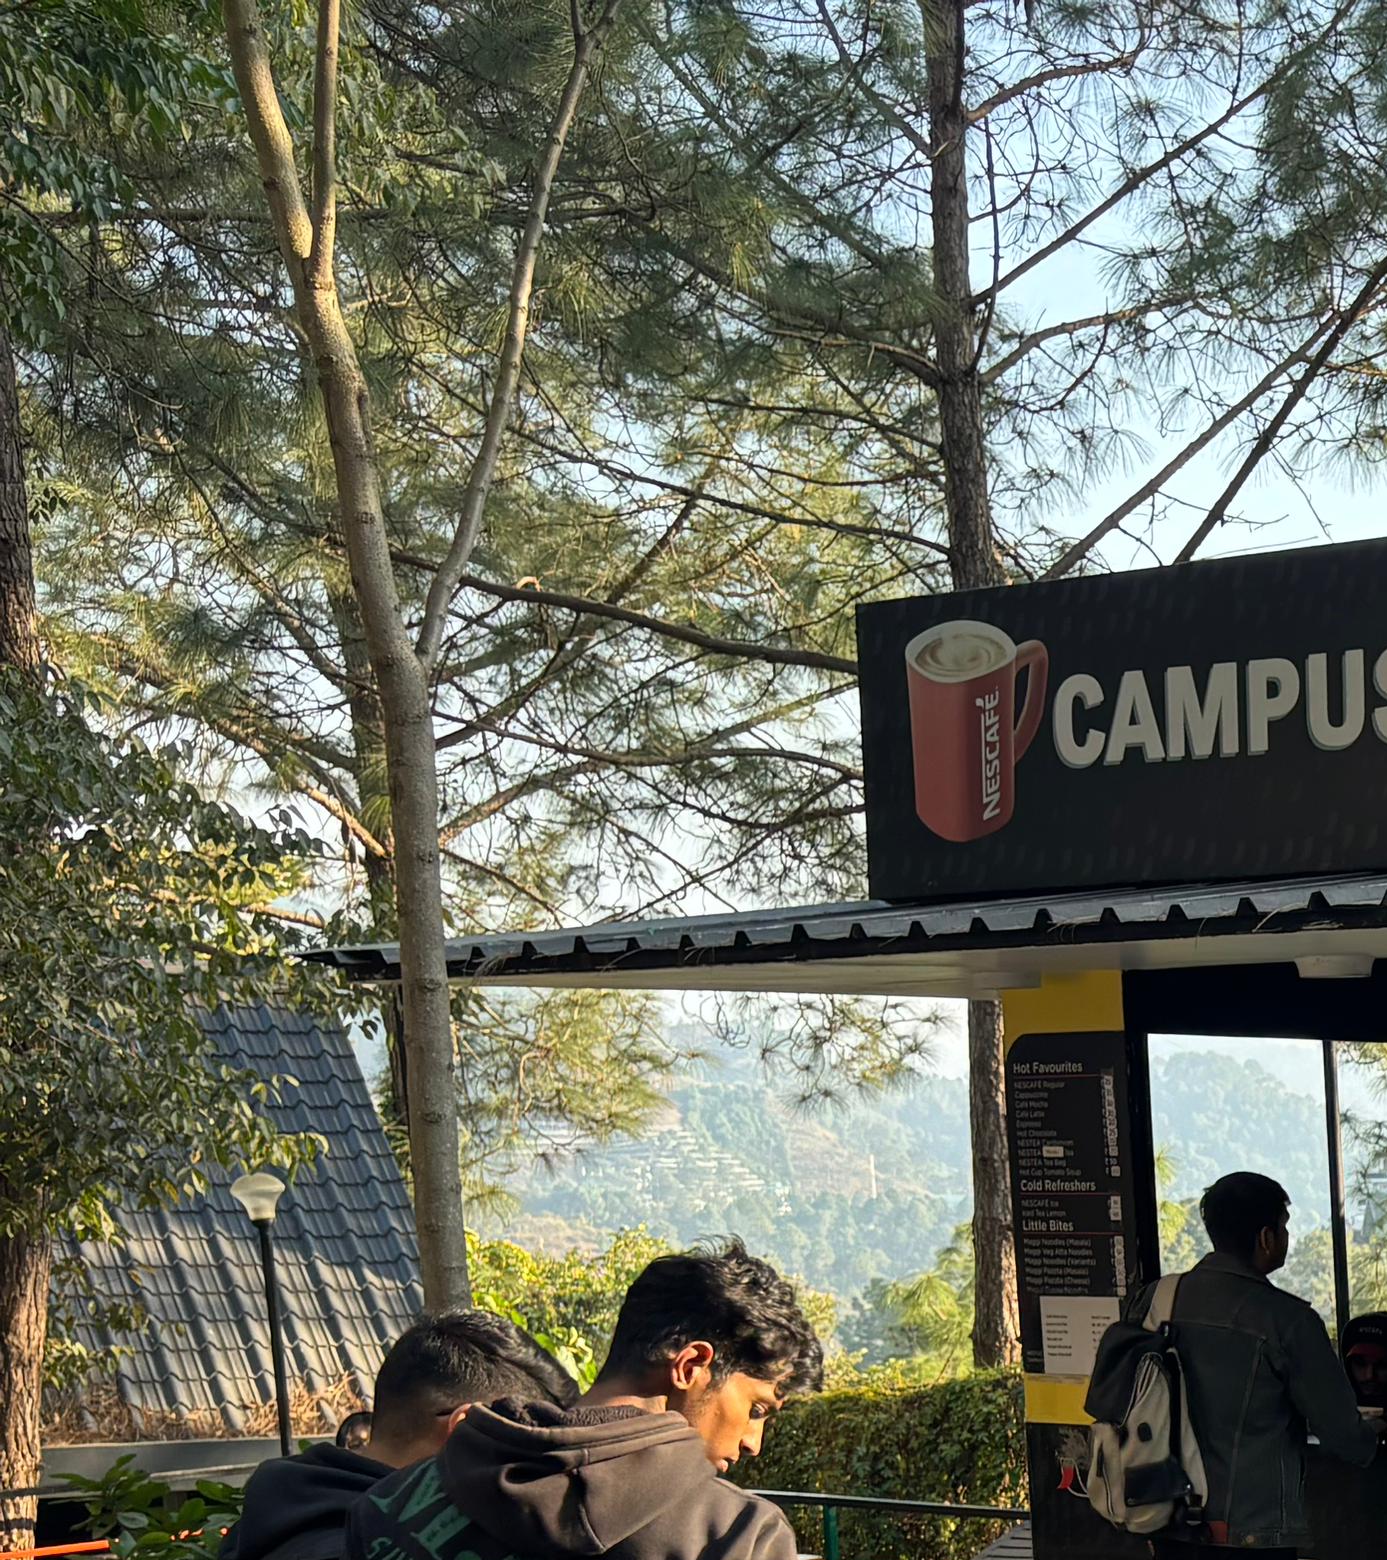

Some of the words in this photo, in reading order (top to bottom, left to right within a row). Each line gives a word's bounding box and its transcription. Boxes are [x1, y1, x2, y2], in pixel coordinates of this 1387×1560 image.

[1013, 1063, 1030, 1074] Hot
[1033, 1061, 1083, 1073] Favourites
[1021, 1180, 1042, 1191] Cold
[1044, 1180, 1096, 1191] Refreshers
[1022, 1220, 1047, 1231] Little
[1049, 1220, 1074, 1231] Bites
